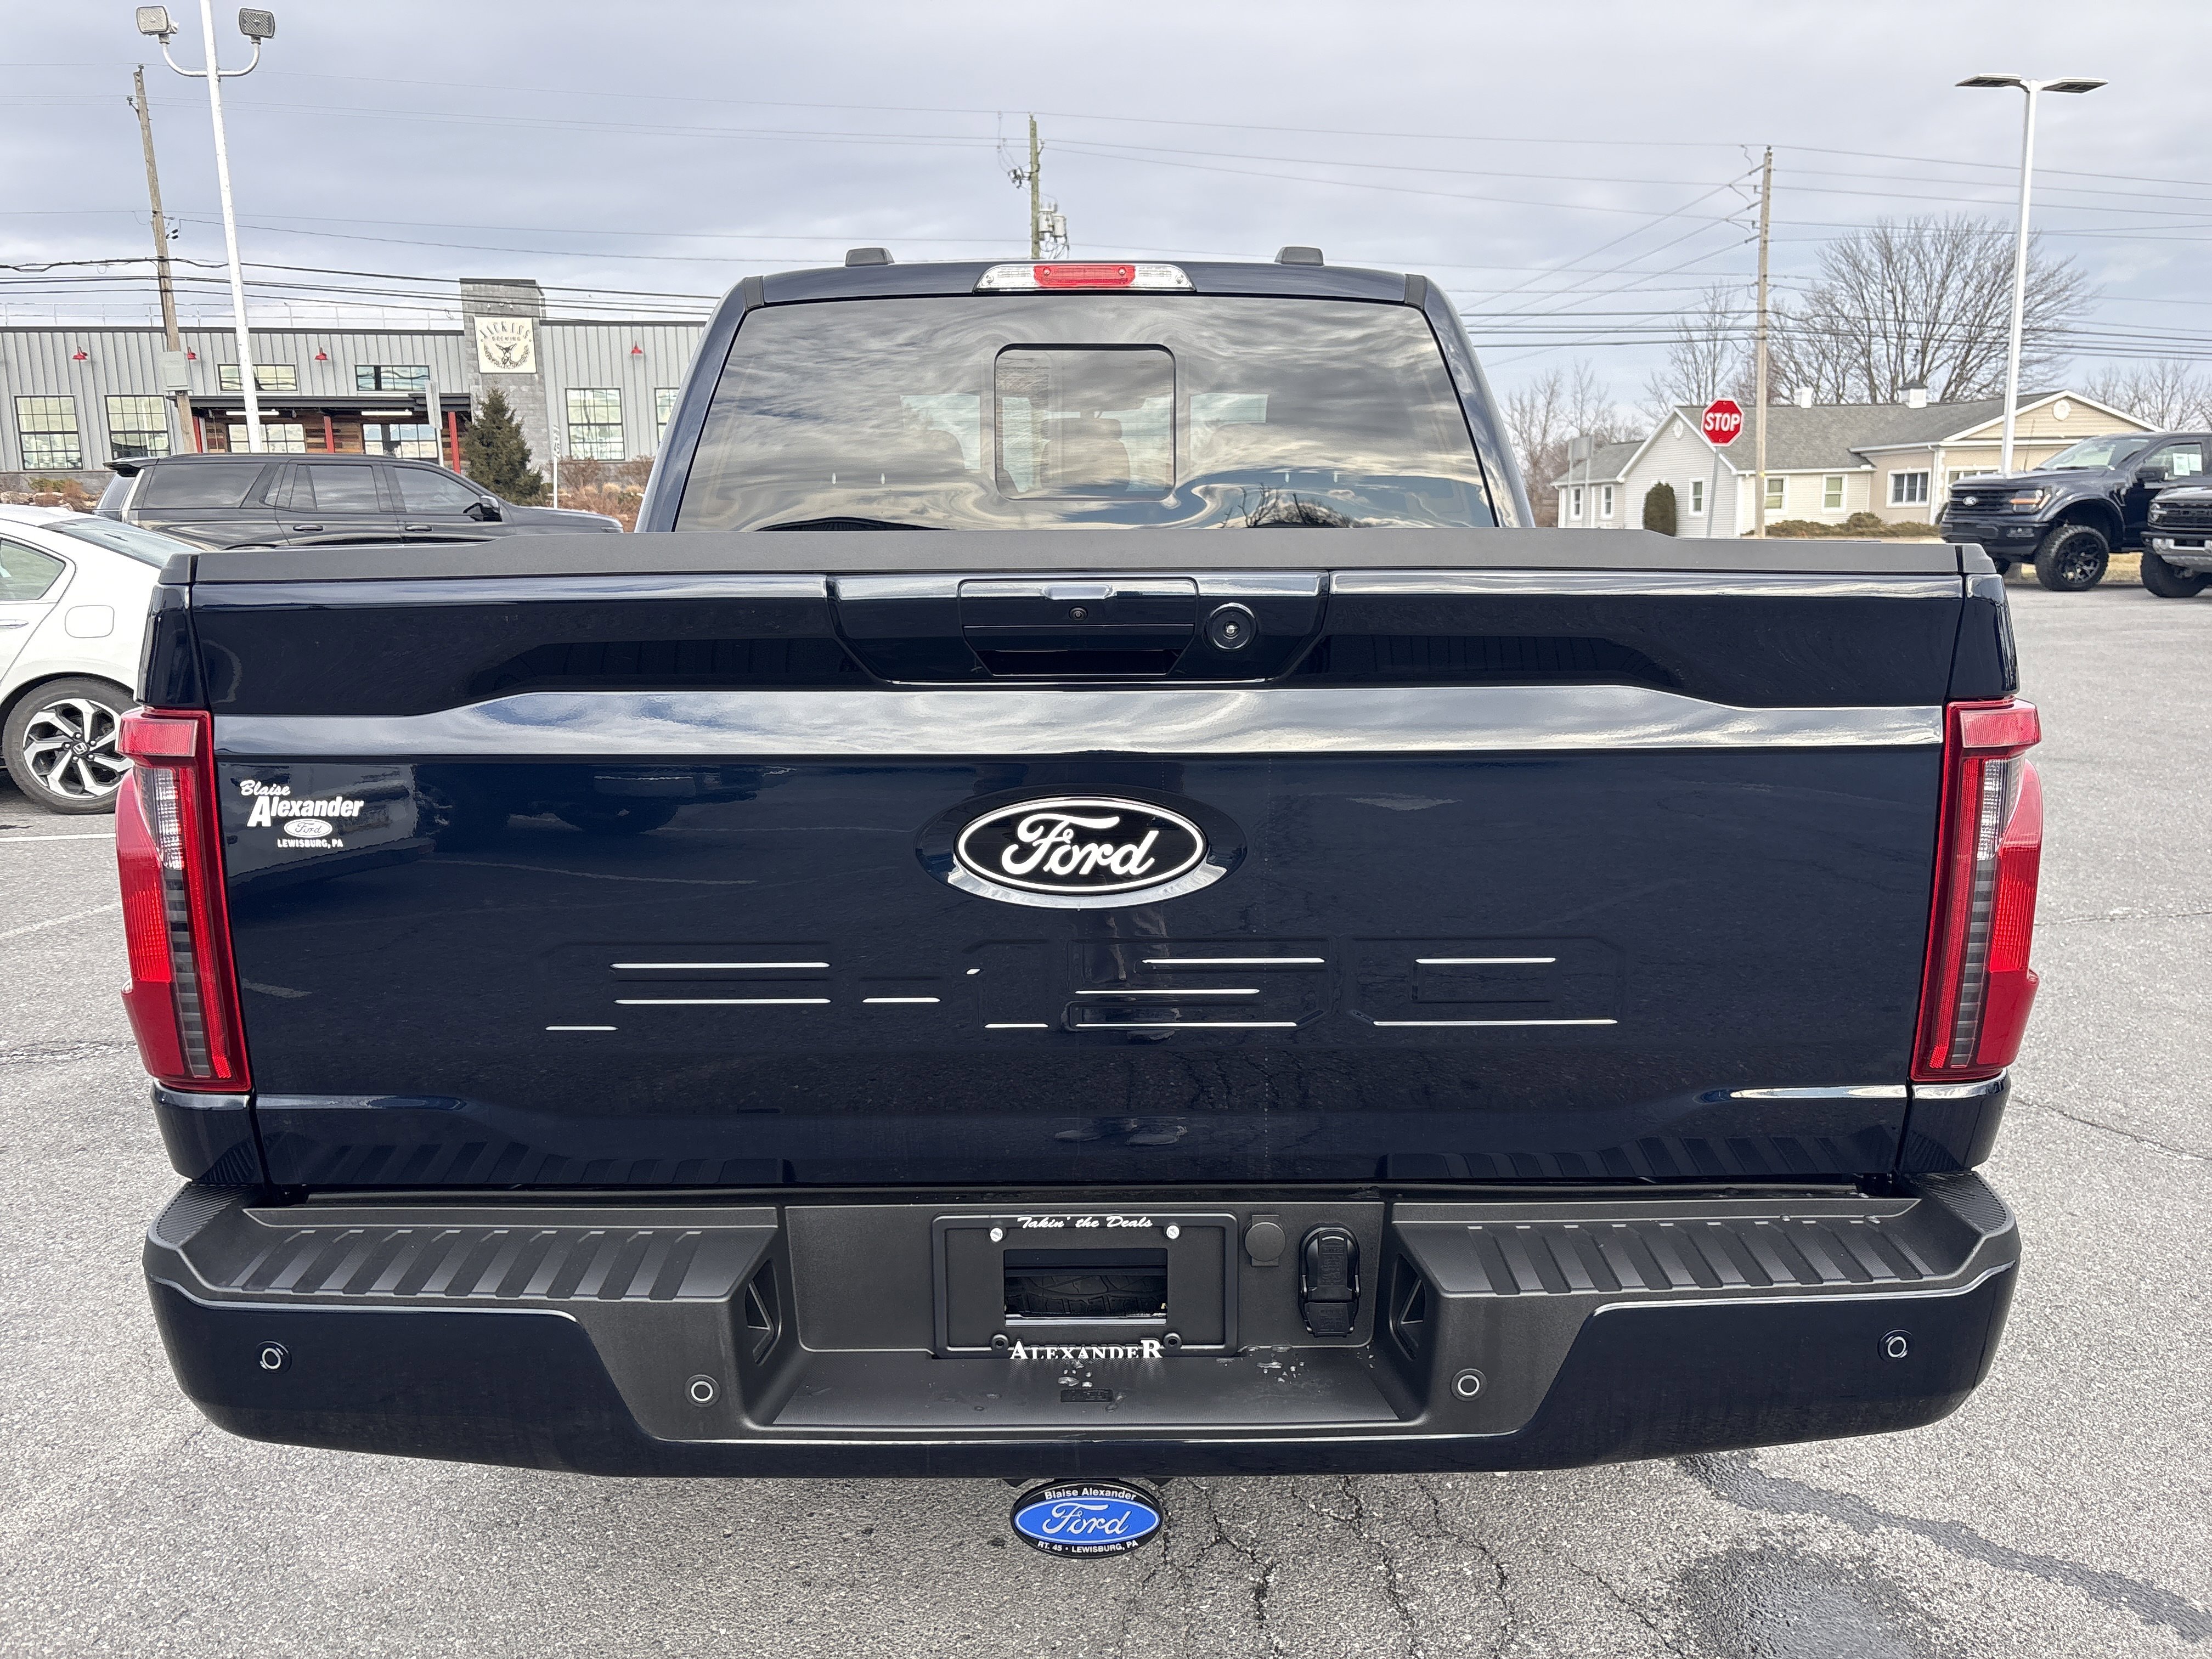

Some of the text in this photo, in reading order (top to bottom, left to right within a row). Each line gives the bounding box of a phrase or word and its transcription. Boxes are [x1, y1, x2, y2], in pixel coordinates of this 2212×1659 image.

[1704, 413, 1740, 432] STOP
[240, 780, 291, 795] Blaise
[247, 795, 364, 827] Alexander
[295, 822, 322, 833] Ford
[277, 839, 331, 849] LEWISBURG,
[1001, 812, 1159, 876] Ford
[1017, 1215, 1153, 1228] Takin' the Deals
[1009, 1339, 1163, 1359] ALEXANDER
[1044, 1487, 1136, 1500] Blaise Alexander
[1042, 1502, 1132, 1534] Ford
[1037, 1541, 1050, 1550] RT.
[1071, 1543, 1125, 1553] LEWISBURG,
